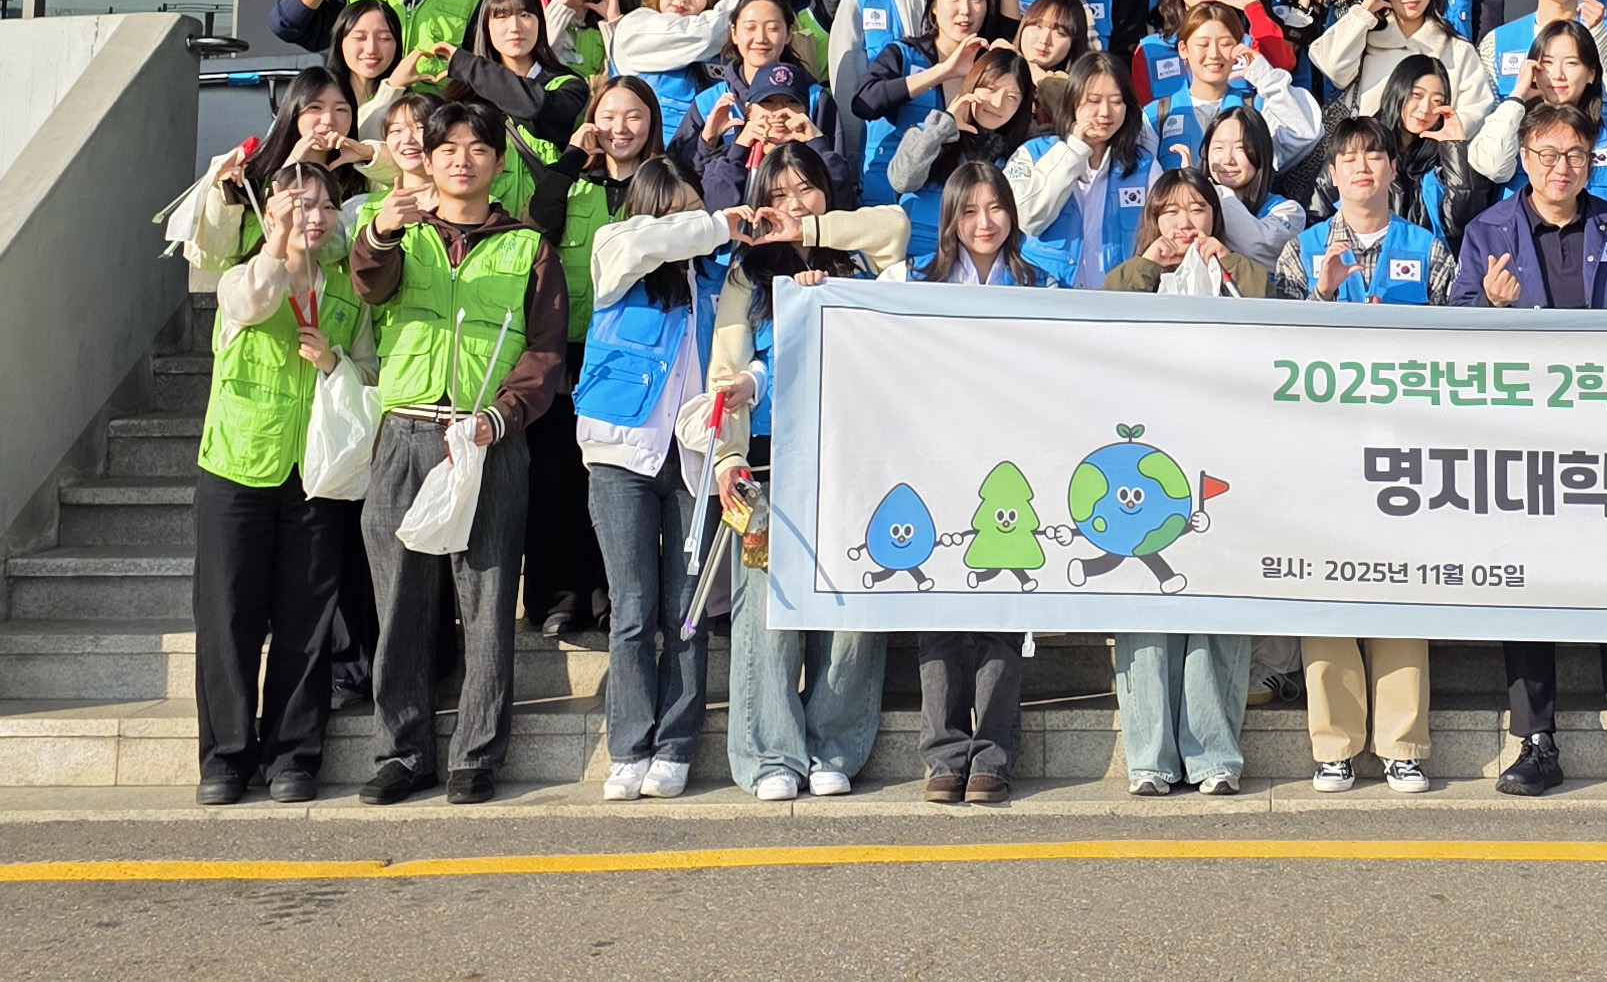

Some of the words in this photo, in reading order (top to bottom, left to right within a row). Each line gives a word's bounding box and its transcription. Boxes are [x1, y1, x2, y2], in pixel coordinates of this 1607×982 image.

[1272, 359, 1534, 407] 2025학년도
[1261, 556, 1313, 580] 일시:
[1324, 560, 1409, 584] 2025년
[1415, 563, 1465, 586] 11월
[1471, 564, 1526, 588] 05일
